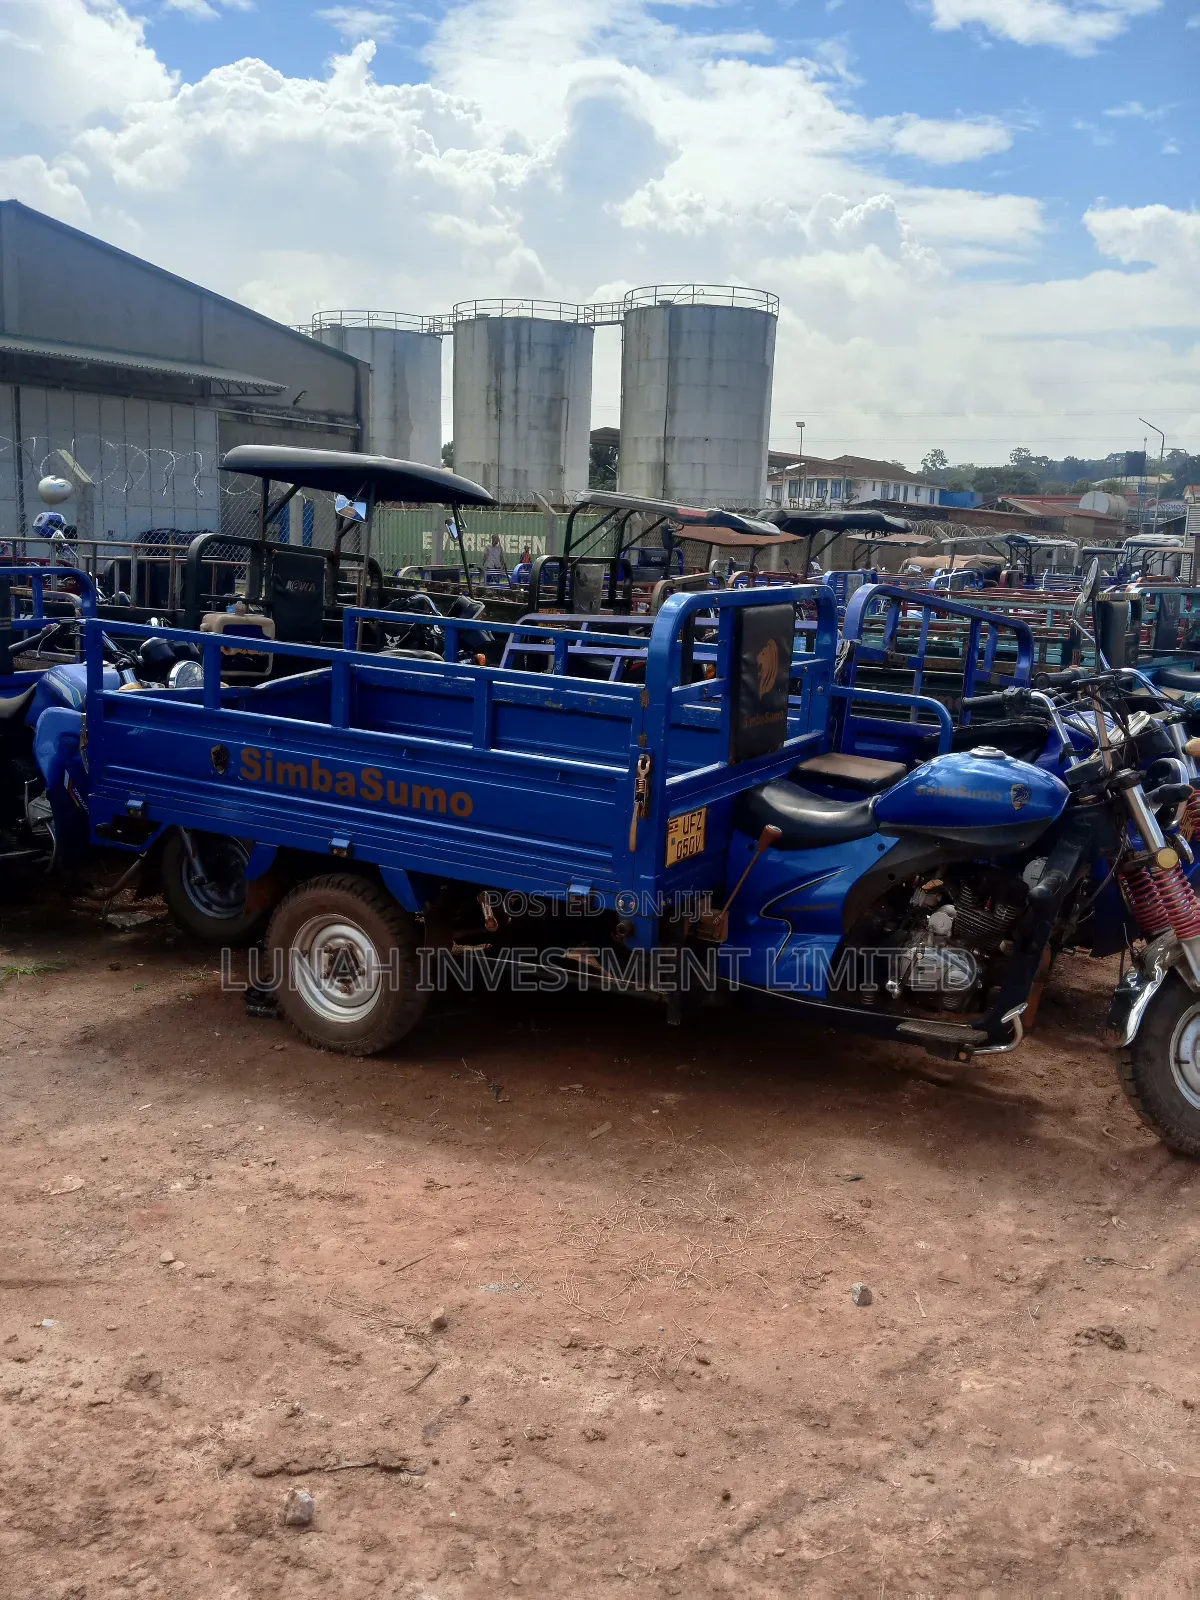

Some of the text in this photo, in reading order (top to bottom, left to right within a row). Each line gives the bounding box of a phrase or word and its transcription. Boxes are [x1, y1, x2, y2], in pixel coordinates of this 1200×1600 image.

[422, 531, 546, 554] ERGEEN
[239, 747, 473, 817] SimbaSumo
[915, 784, 1003, 801] SimbaSumo
[682, 811, 703, 835] UFZ
